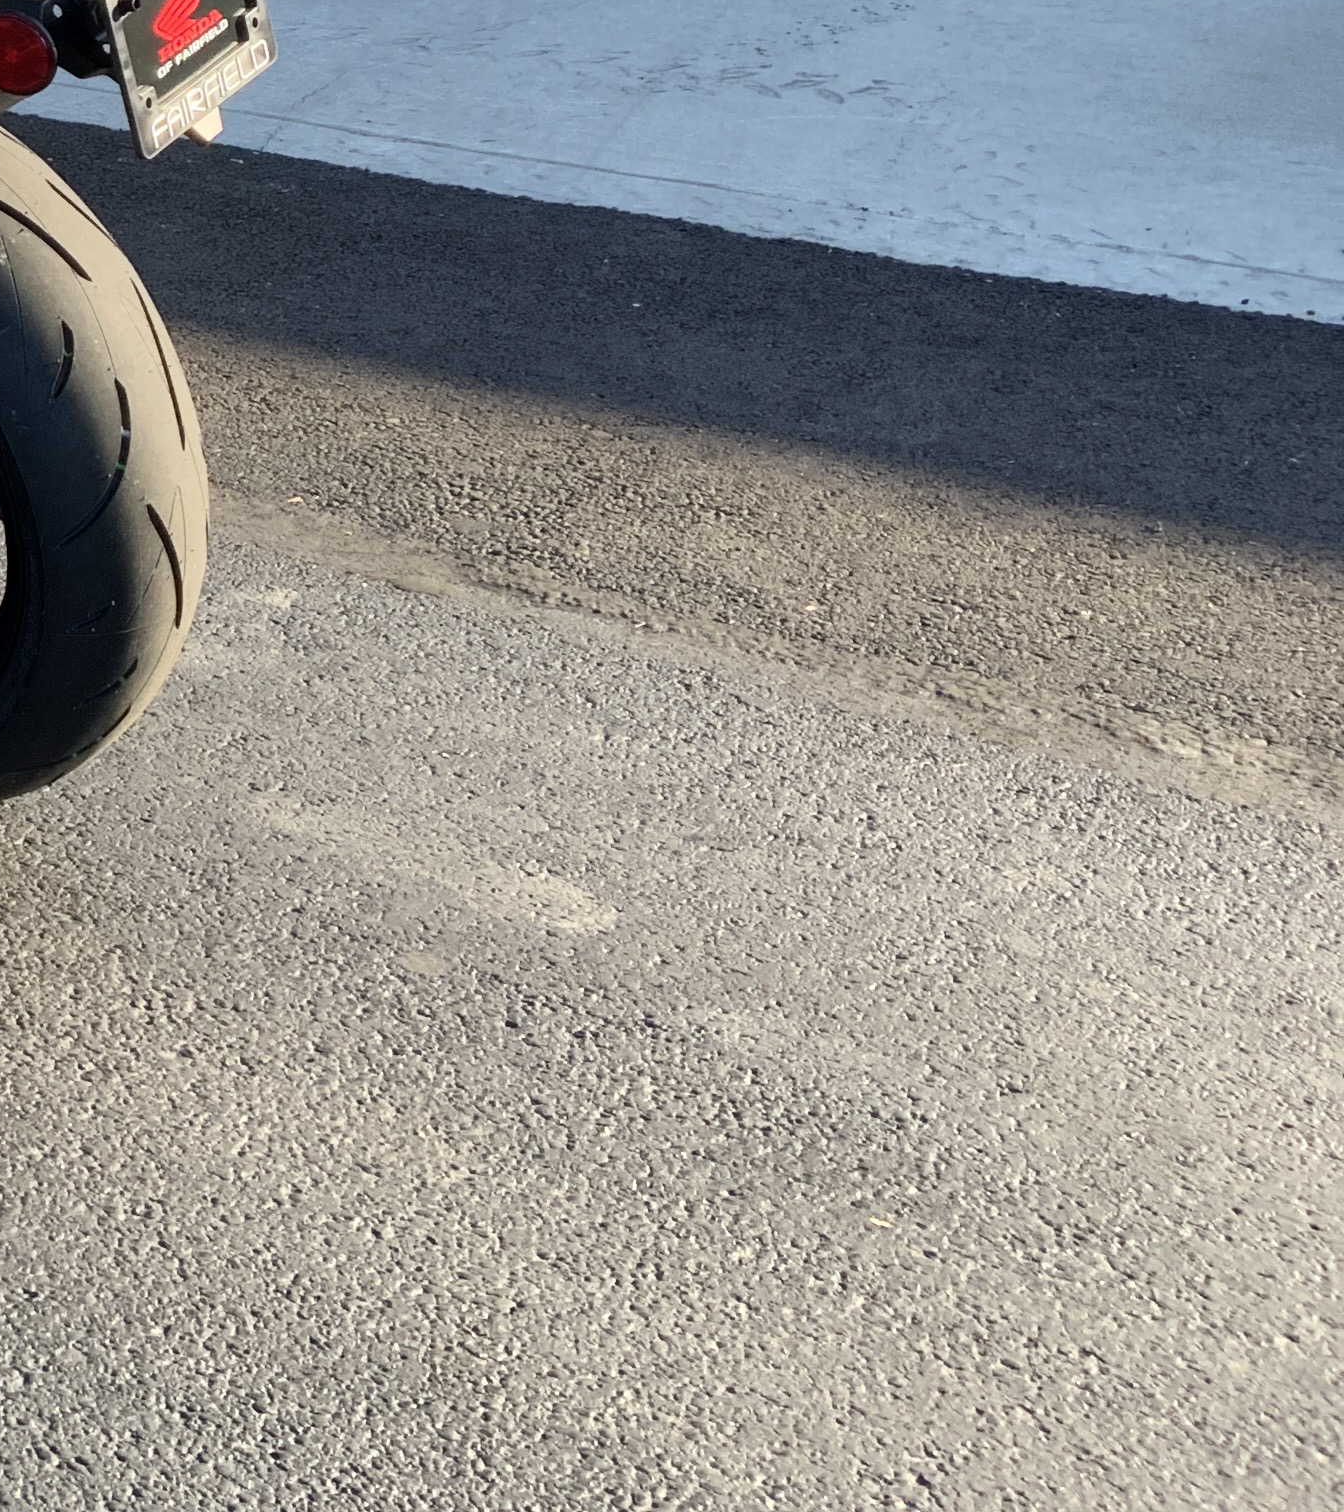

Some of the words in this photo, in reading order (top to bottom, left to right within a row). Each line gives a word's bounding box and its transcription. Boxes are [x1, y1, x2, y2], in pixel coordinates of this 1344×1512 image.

[156, 63, 174, 79] OF
[175, 18, 229, 66] FAIRFIELD
[157, 9, 223, 62] HONDA
[151, 39, 270, 150] FAIRFIELD
